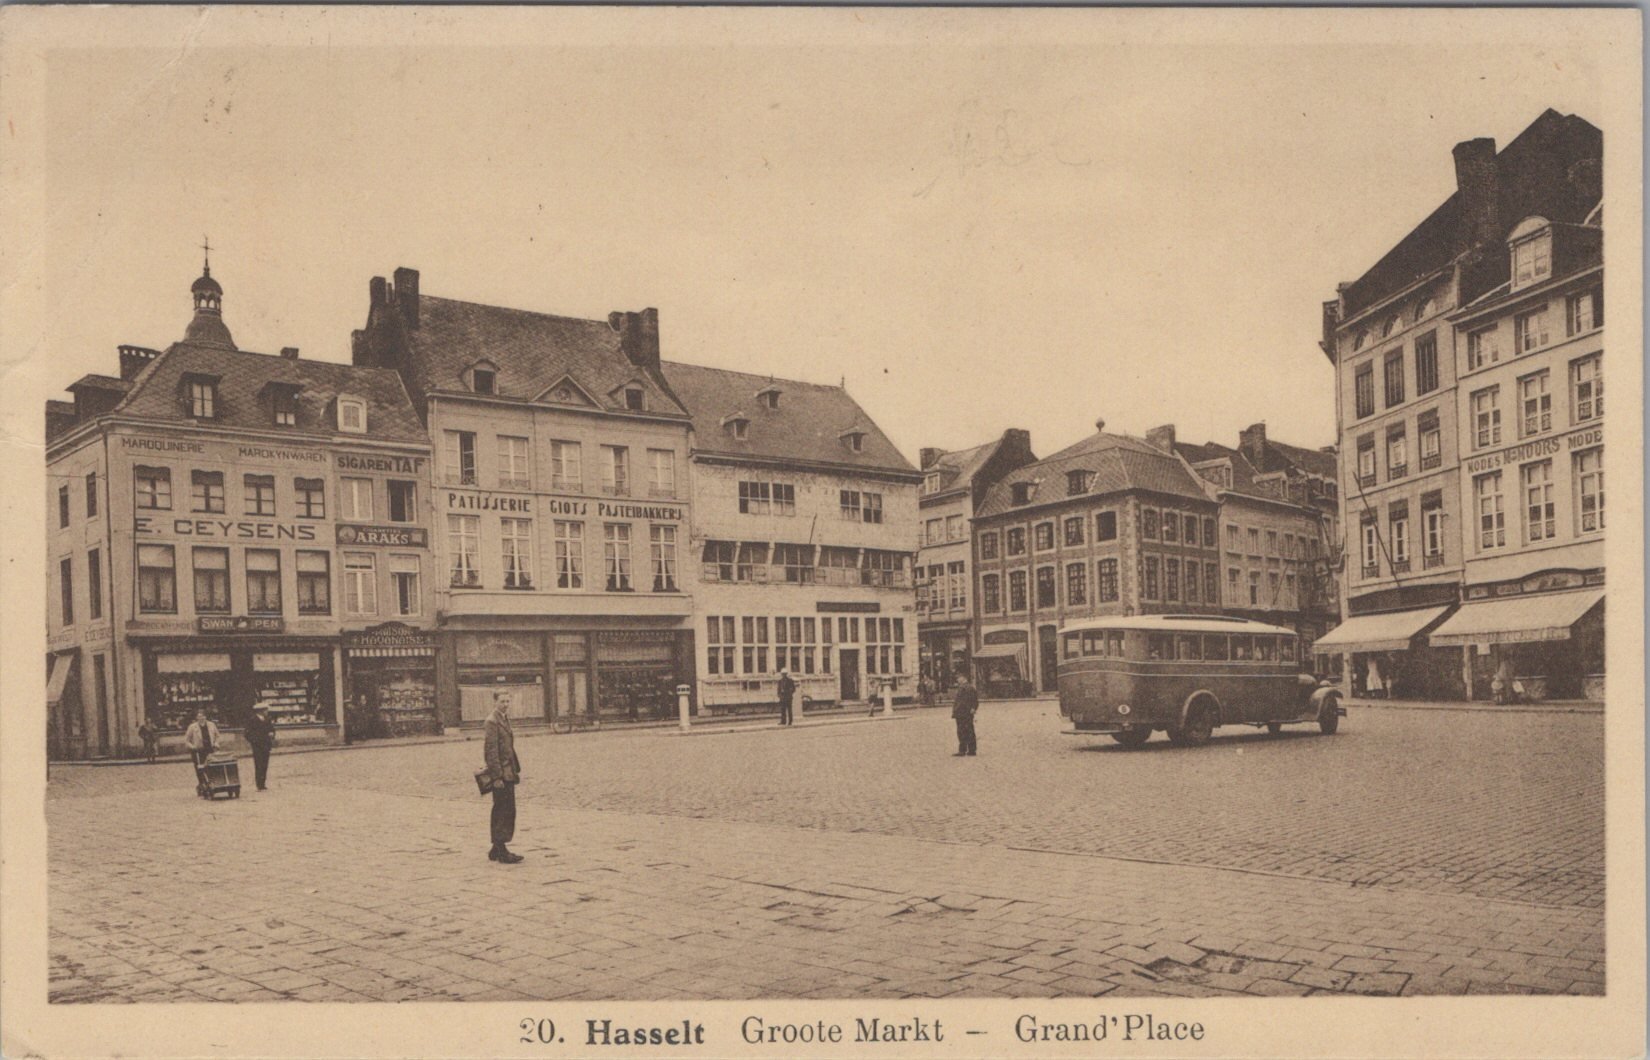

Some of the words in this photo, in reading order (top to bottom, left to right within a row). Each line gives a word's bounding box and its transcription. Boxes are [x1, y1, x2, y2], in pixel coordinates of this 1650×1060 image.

[122, 438, 205, 454] MAROQUINERIE
[338, 456, 392, 471] SIGAREN
[391, 456, 425, 473] TAF
[449, 493, 531, 512] PATISSERIE
[550, 500, 587, 515] GIOTS
[135, 518, 161, 533] E.
[174, 519, 316, 540] CEYSENS
[355, 531, 409, 544] ARAKS
[201, 619, 233, 630] SWAN
[254, 618, 279, 628] PEN
